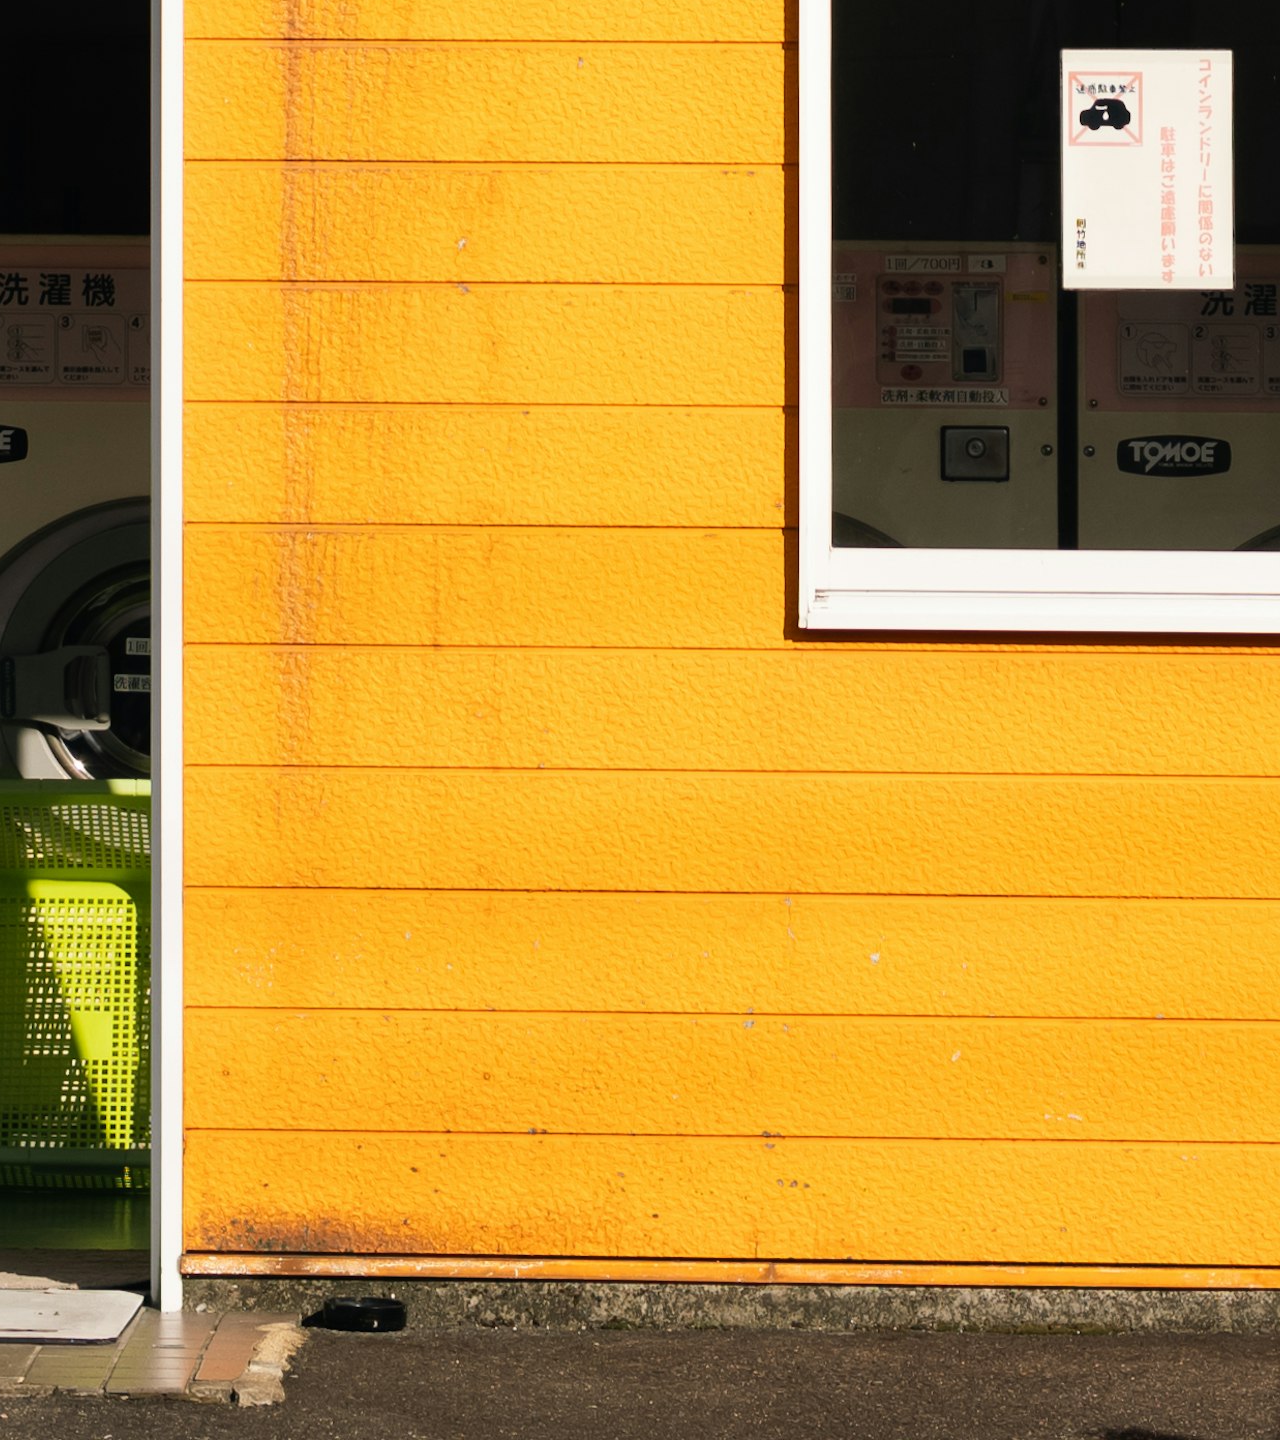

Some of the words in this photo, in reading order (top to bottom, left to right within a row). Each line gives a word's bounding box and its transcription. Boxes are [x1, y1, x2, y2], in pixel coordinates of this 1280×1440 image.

[1198, 59, 1213, 277] コインランドリーに関係のない
[1160, 127, 1176, 283] 駐車はご遠慮願います
[62, 317, 70, 327] 3
[131, 317, 140, 328] 4
[1196, 326, 1203, 337] 2
[1266, 327, 1274, 337] 3
[882, 389, 1008, 403] 洗剤・柔軟剤自動投入
[1128, 440, 1219, 473] TOMOE
